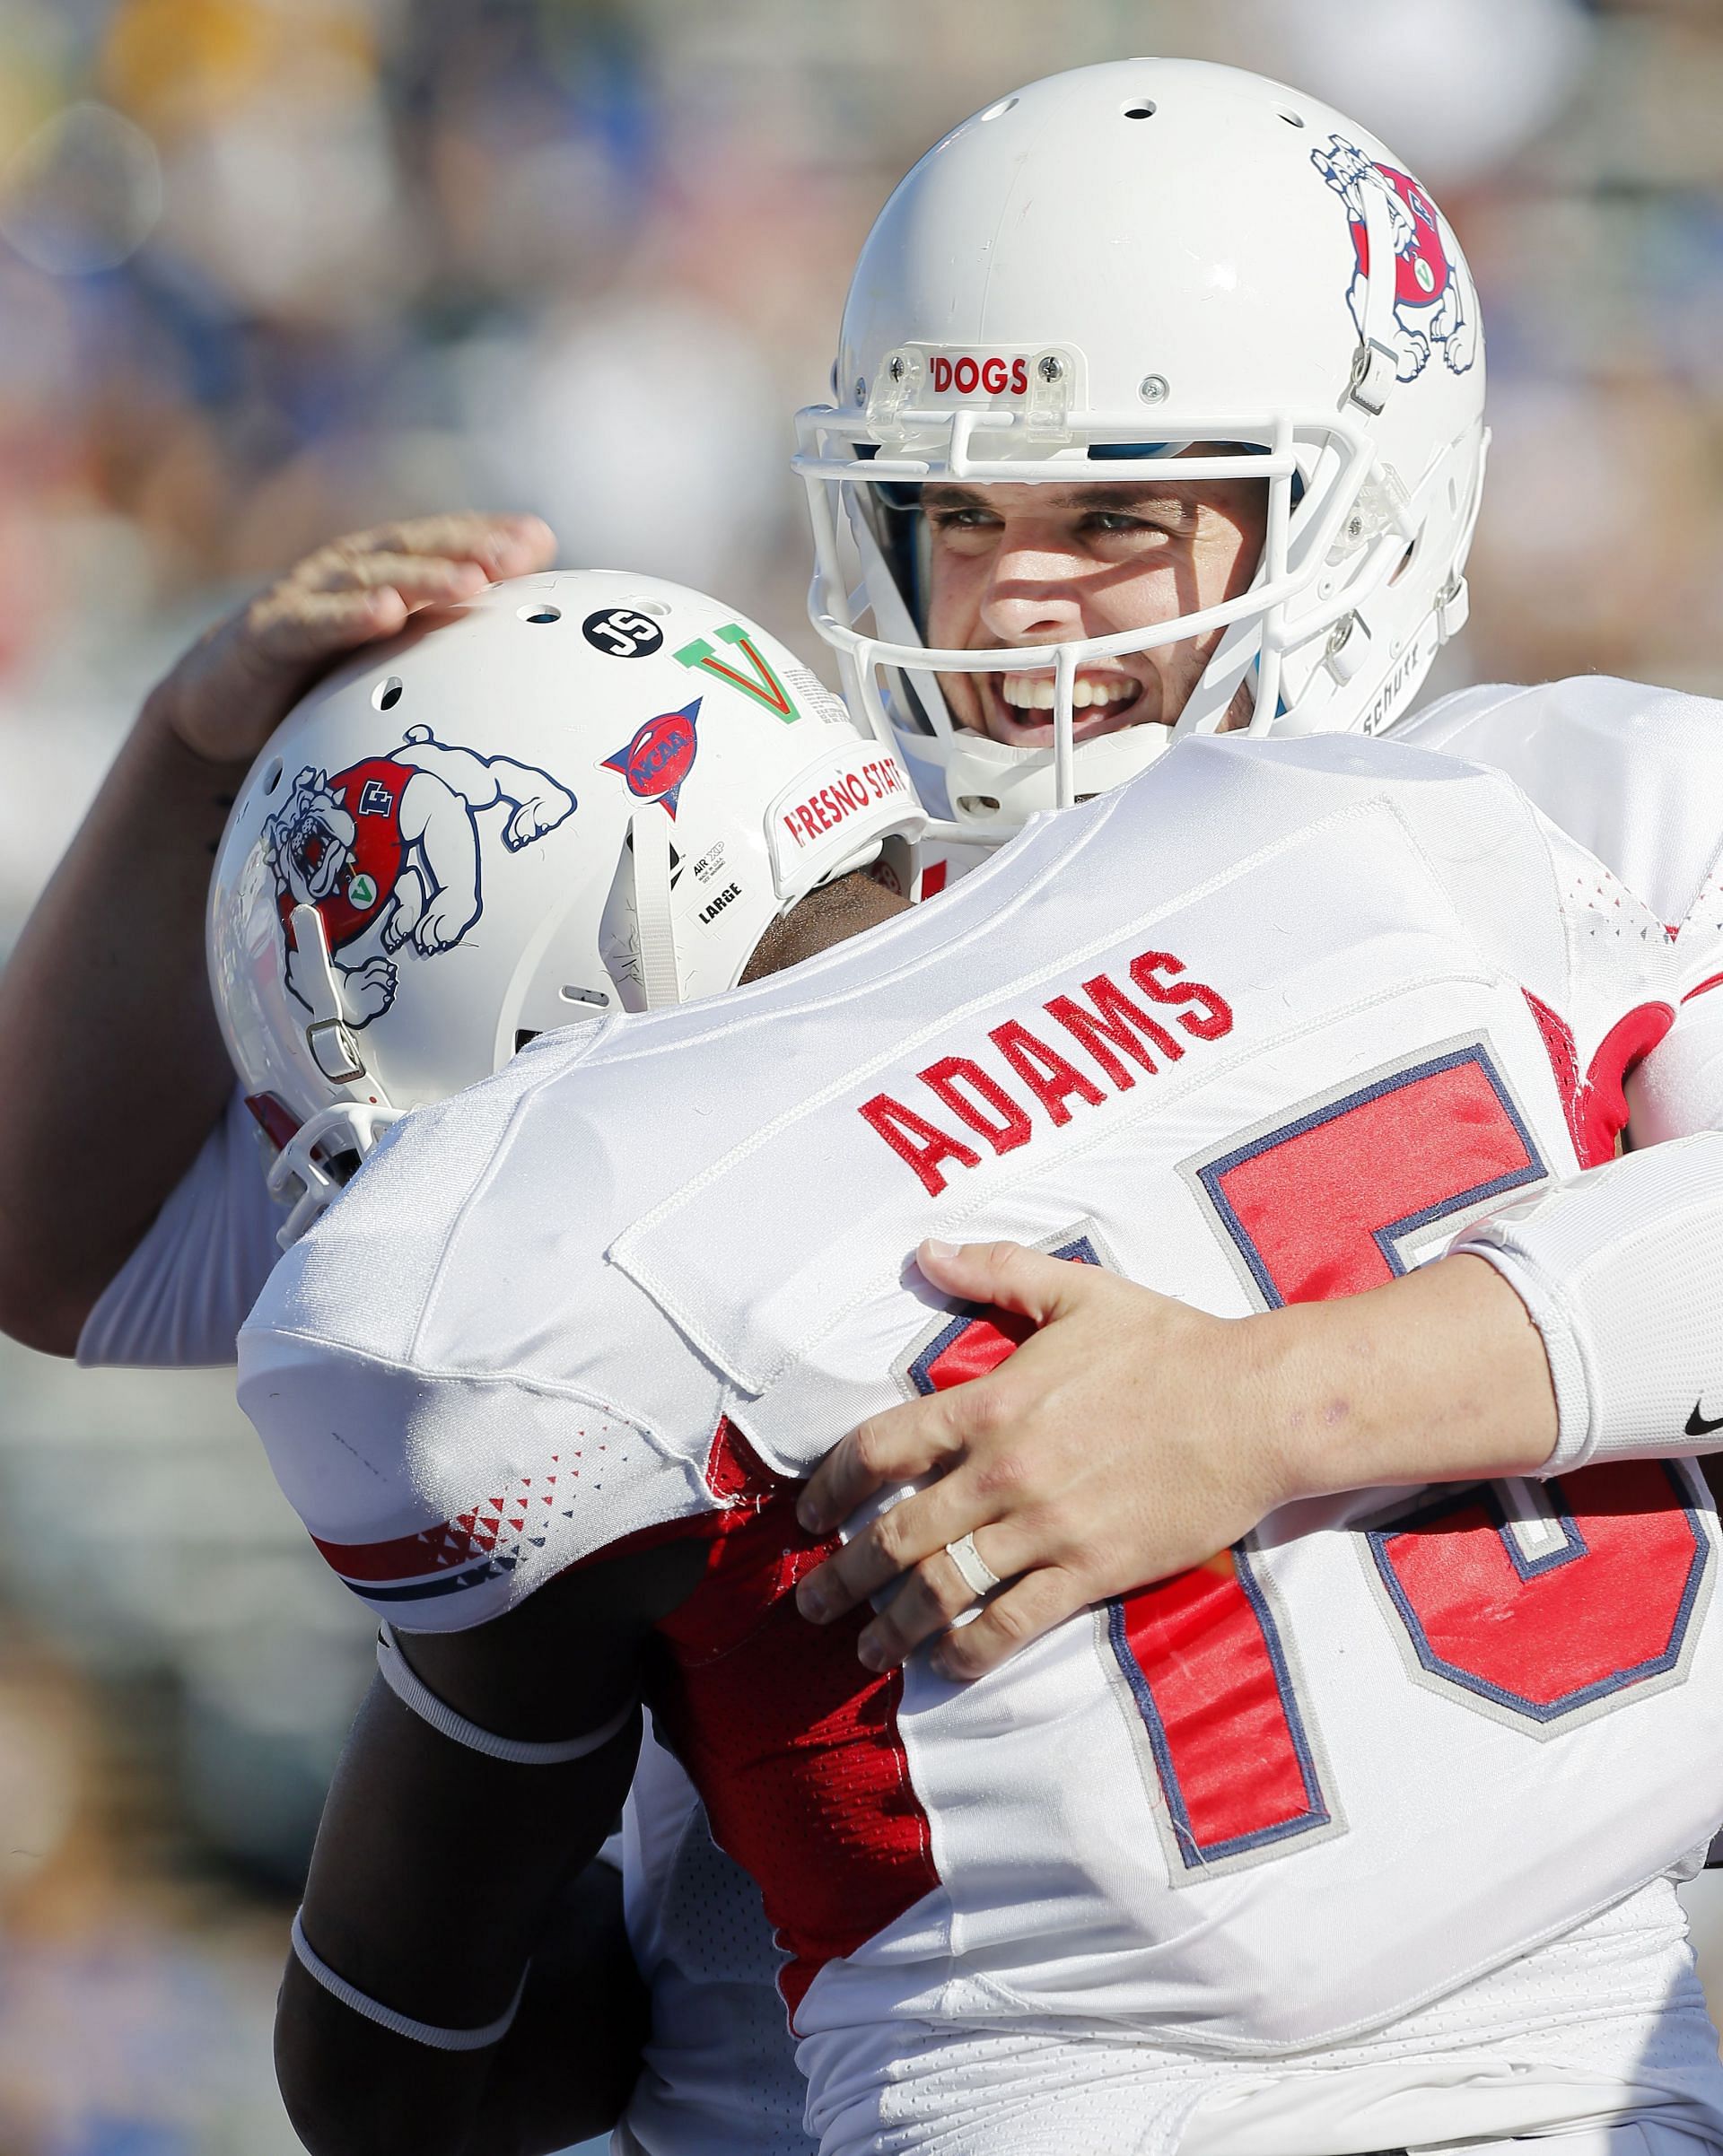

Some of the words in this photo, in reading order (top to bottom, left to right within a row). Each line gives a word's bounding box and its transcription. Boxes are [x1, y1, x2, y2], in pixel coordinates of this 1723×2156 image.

[1417, 263, 1431, 288] V
[591, 611, 659, 656] JS
[672, 623, 801, 725] V
[630, 732, 687, 787] NCAA
[783, 773, 870, 848] FRESNO
[351, 877, 373, 903] V
[694, 859, 709, 877] AIR
[698, 882, 742, 924] LARGE
[858, 950, 1233, 1197] ADAMS
